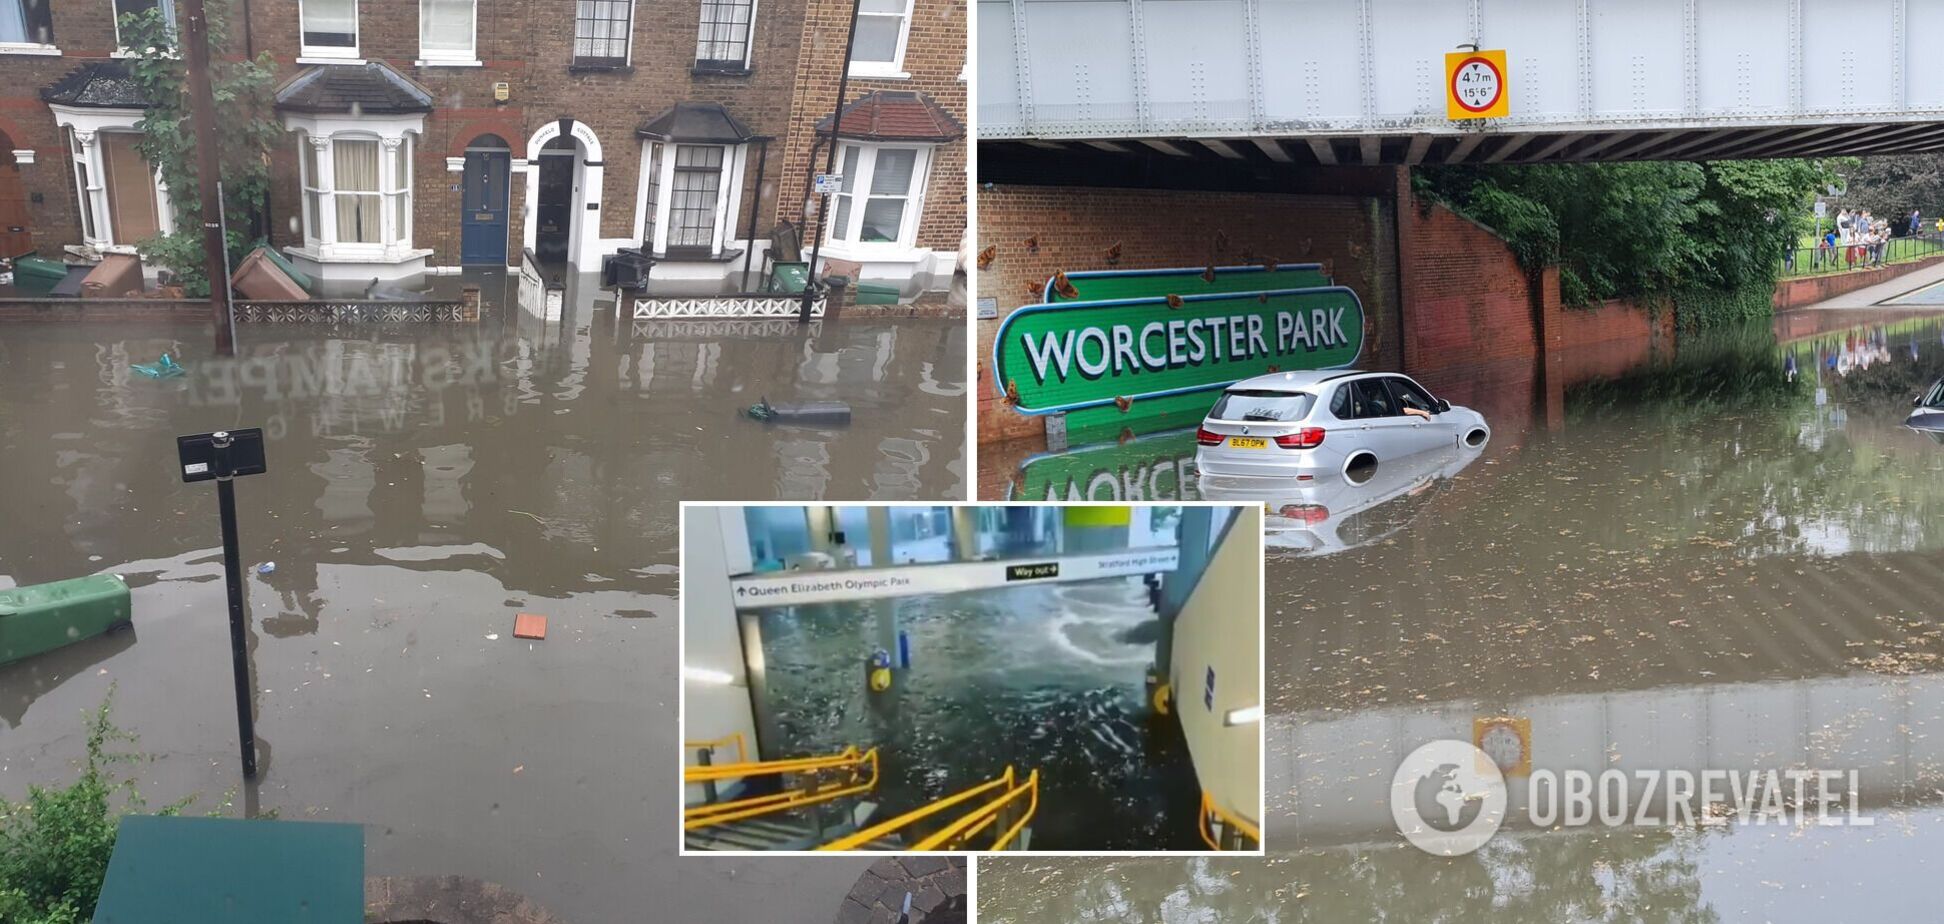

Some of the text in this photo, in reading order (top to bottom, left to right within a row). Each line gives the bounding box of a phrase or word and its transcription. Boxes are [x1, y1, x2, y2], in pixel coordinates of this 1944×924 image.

[1022, 306, 1349, 384] WORCESTER PARK
[1014, 566, 1049, 577] Way out
[748, 577, 909, 596] Queen Elizabeth Olympic Park
